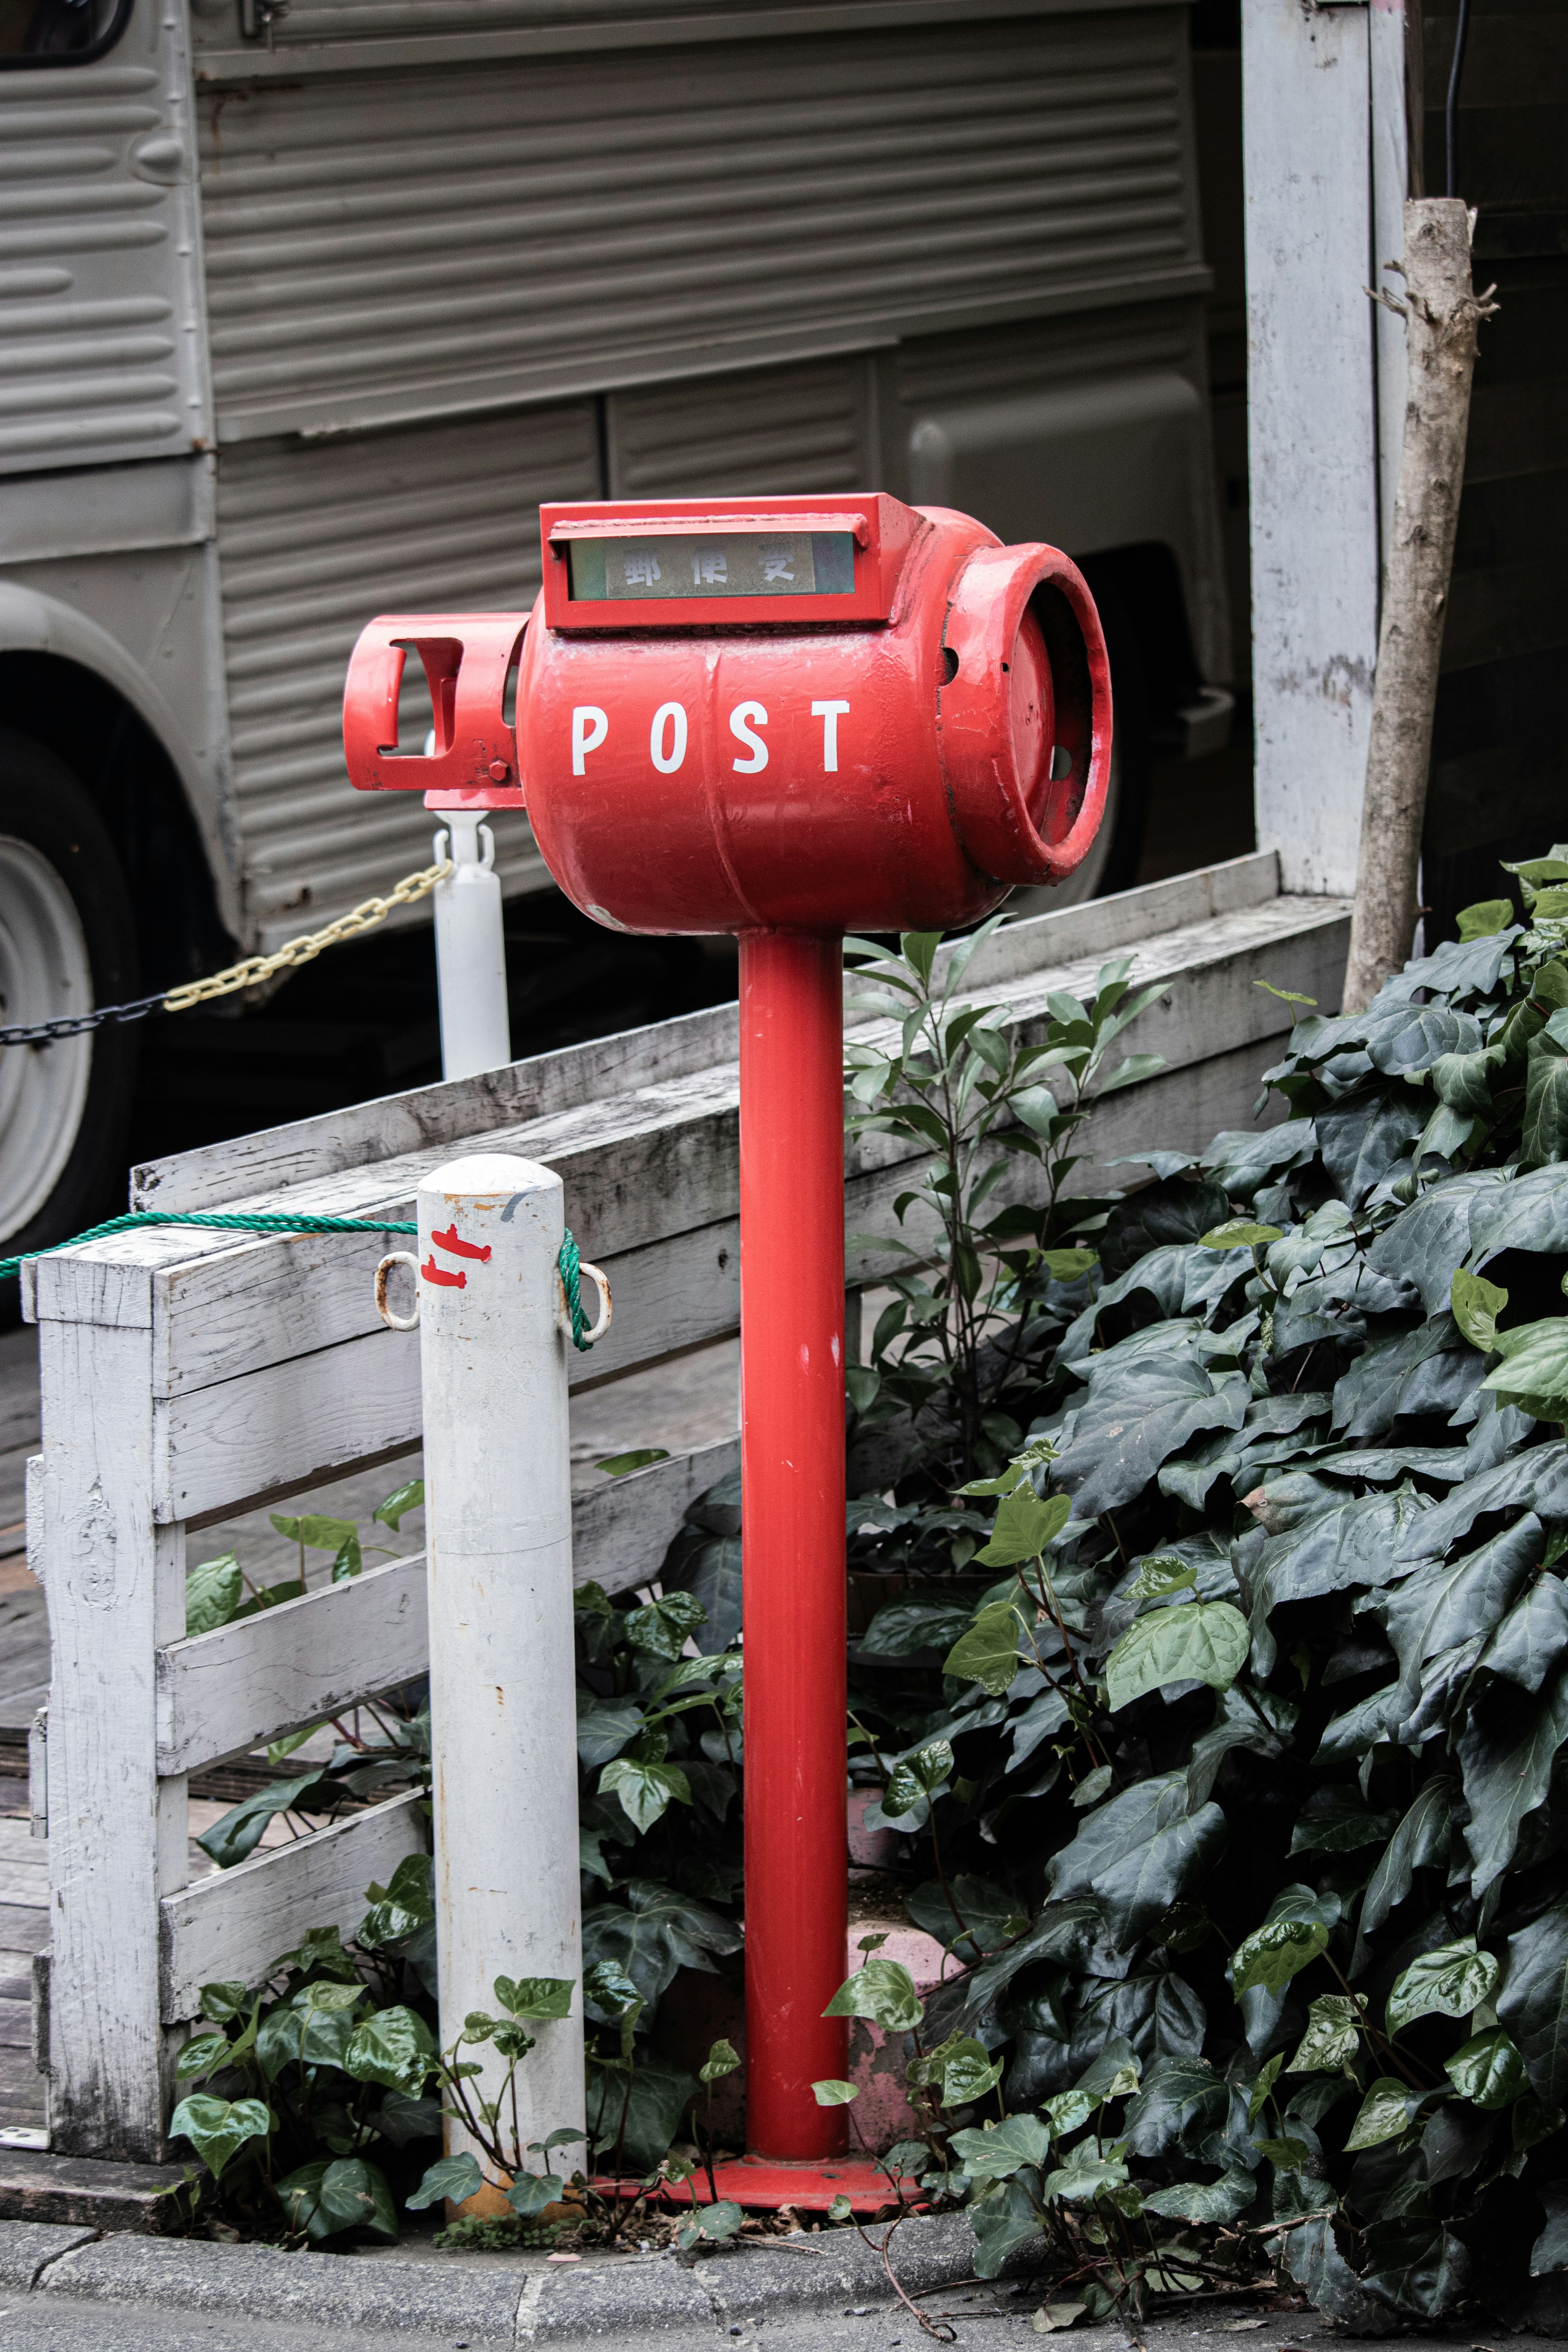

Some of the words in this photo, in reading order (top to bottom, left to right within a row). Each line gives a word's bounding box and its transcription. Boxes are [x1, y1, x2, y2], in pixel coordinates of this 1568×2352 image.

[623, 544, 795, 586] 郵便受
[572, 700, 850, 776] POST
